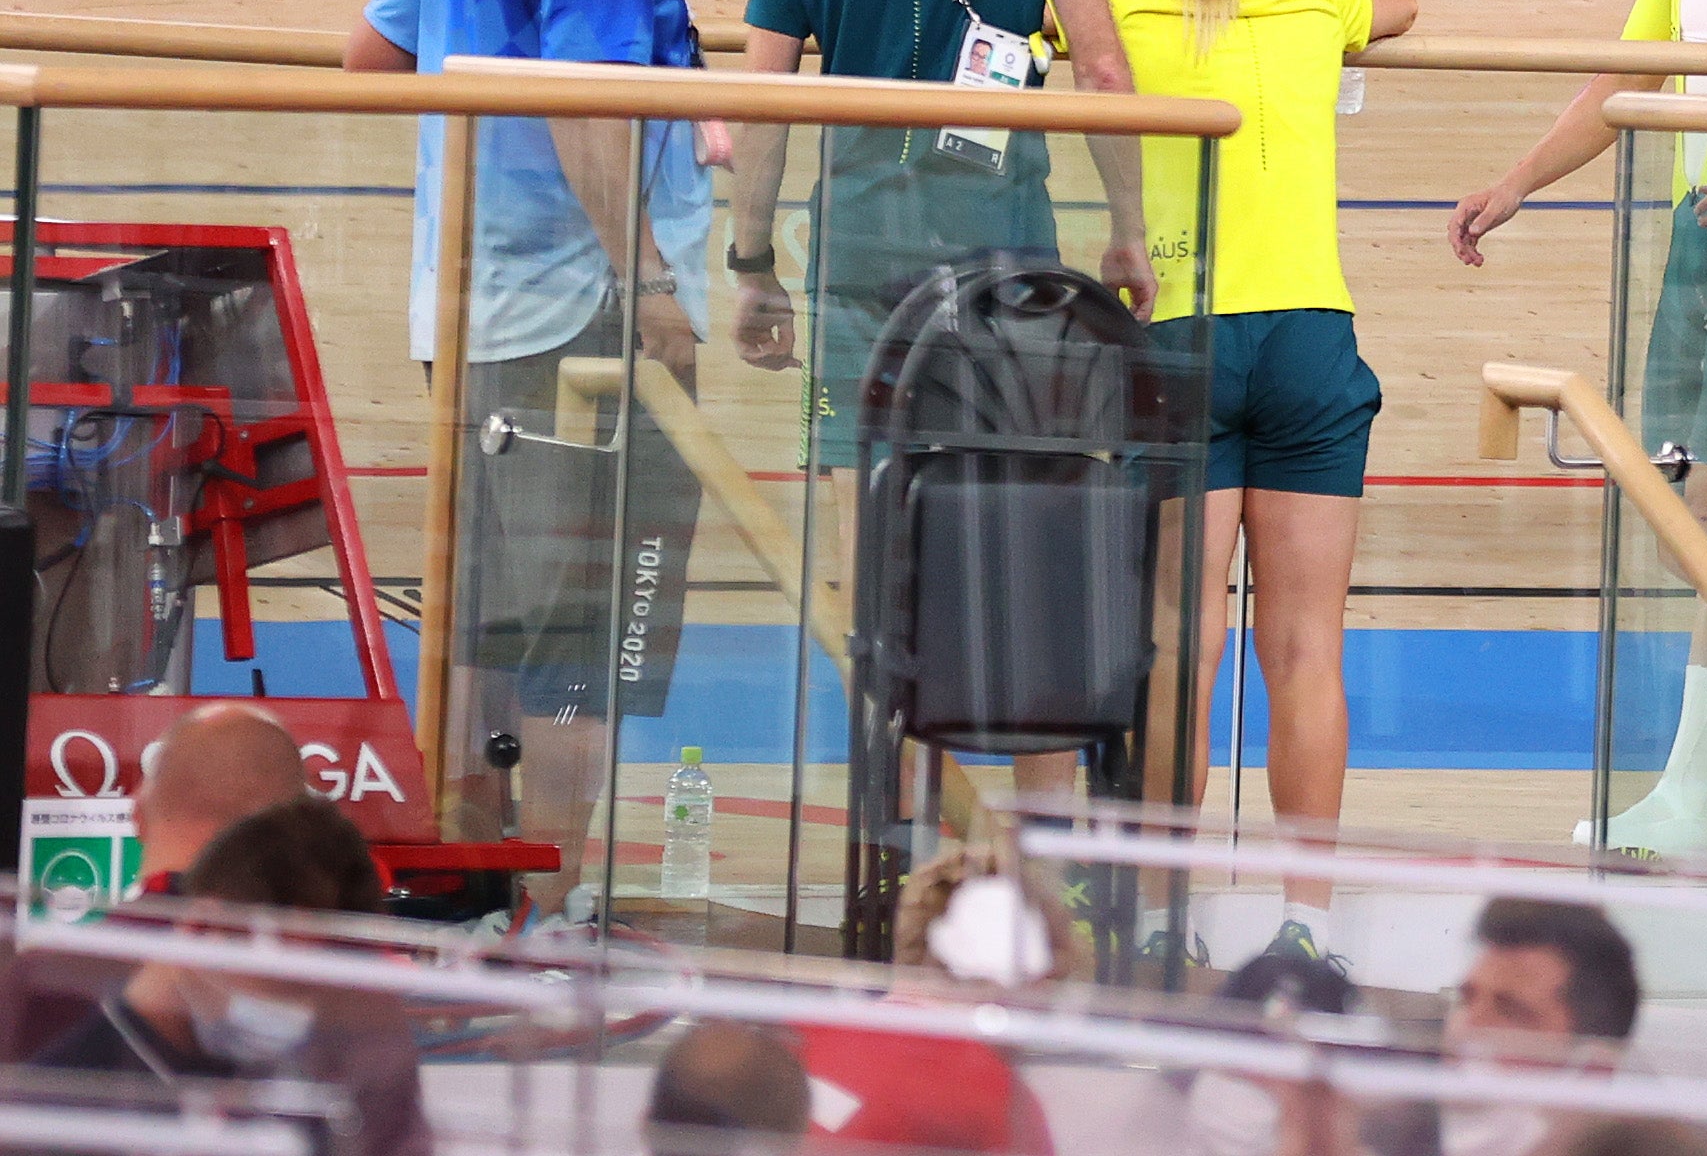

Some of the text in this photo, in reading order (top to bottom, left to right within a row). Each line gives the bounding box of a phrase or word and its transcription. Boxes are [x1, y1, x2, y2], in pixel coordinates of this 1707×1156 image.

[1151, 240, 1189, 261] AUS
[619, 536, 662, 682] TOKYO 2020
